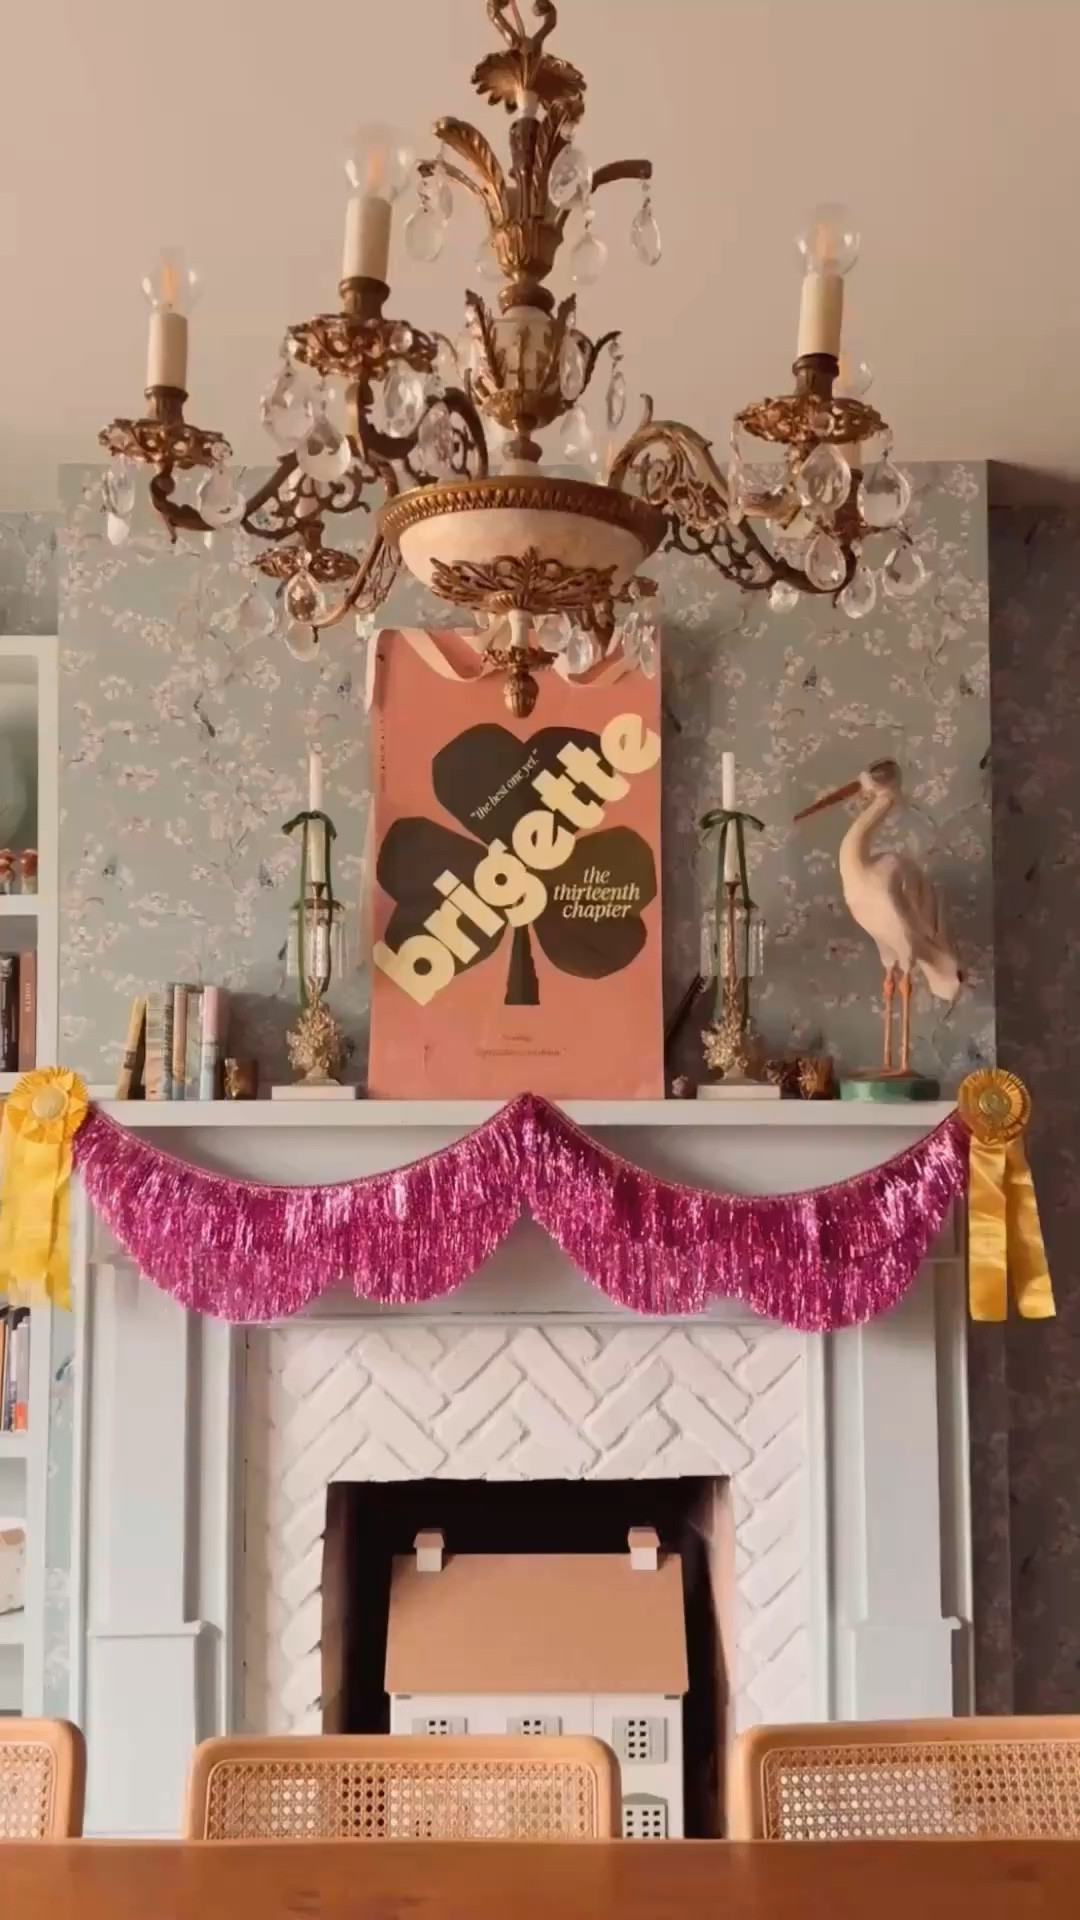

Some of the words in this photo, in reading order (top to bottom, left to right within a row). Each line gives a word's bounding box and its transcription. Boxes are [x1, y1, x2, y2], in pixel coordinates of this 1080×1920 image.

[487, 784, 509, 807] best
[506, 769, 523, 789] one
[372, 713, 661, 1007] brigette
[583, 865, 611, 884] the
[553, 882, 640, 901] thirteenth
[562, 901, 632, 923] chapter
